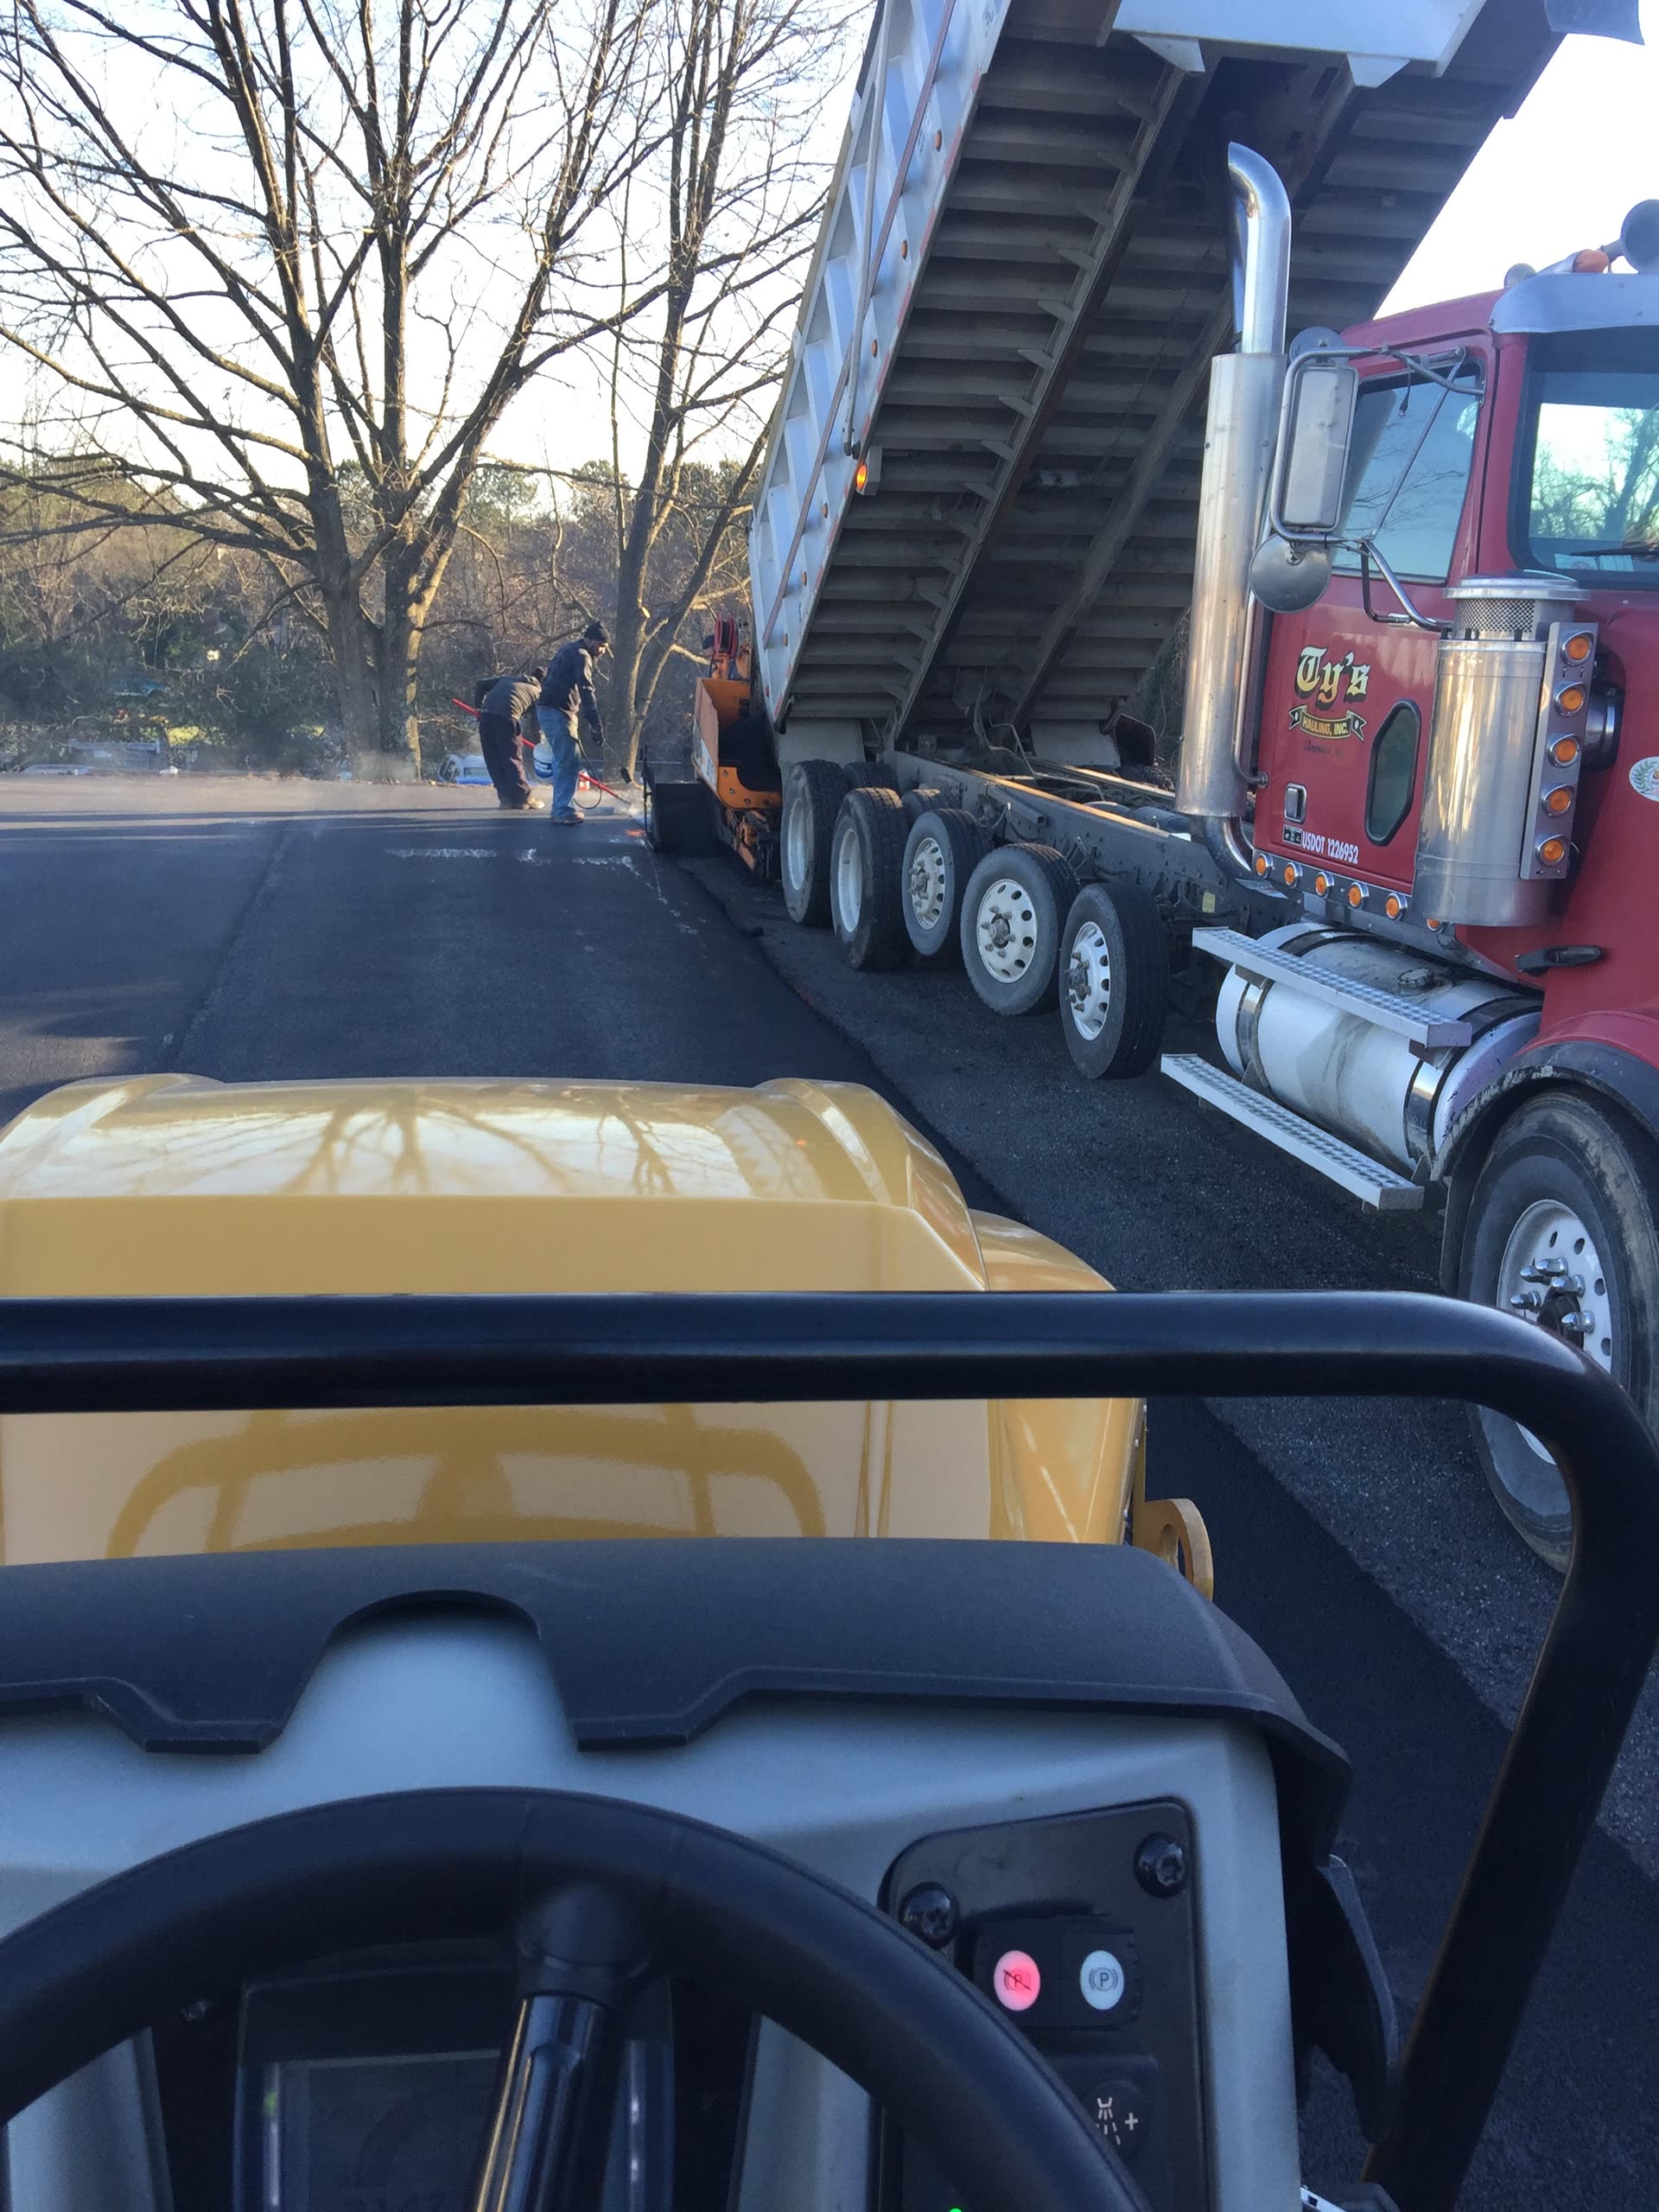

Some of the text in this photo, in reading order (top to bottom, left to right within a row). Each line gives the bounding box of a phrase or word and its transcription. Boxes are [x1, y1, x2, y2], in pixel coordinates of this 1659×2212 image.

[1296, 645, 1370, 705] Ty's
[1302, 716, 1349, 736] HAULING, INC.
[1302, 830, 1325, 855] USDOT
[1327, 837, 1359, 864] 1226952
